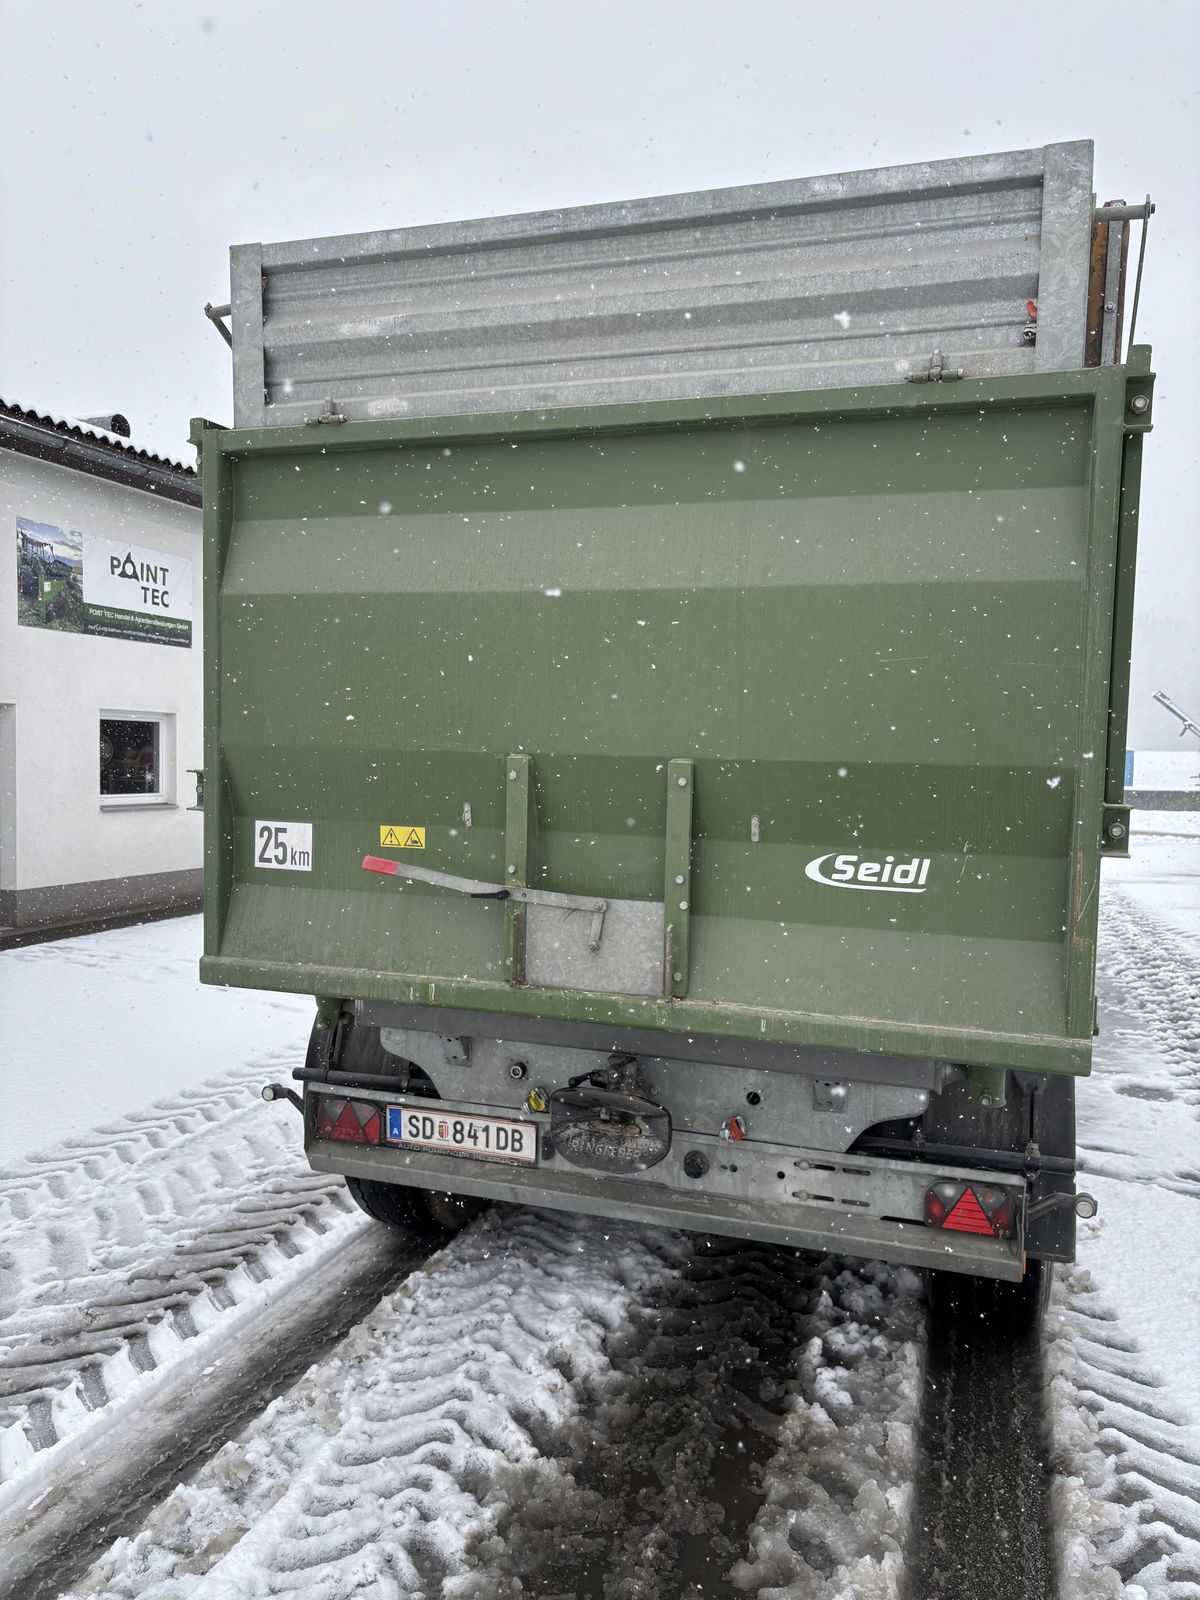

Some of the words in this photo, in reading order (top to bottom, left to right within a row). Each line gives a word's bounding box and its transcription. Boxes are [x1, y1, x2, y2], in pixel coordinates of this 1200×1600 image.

[141, 586, 170, 608] TEC
[258, 825, 288, 865] 25
[291, 847, 310, 867] km
[830, 854, 931, 886] Seidl
[392, 1127, 399, 1136] A
[408, 1114, 435, 1140] SD
